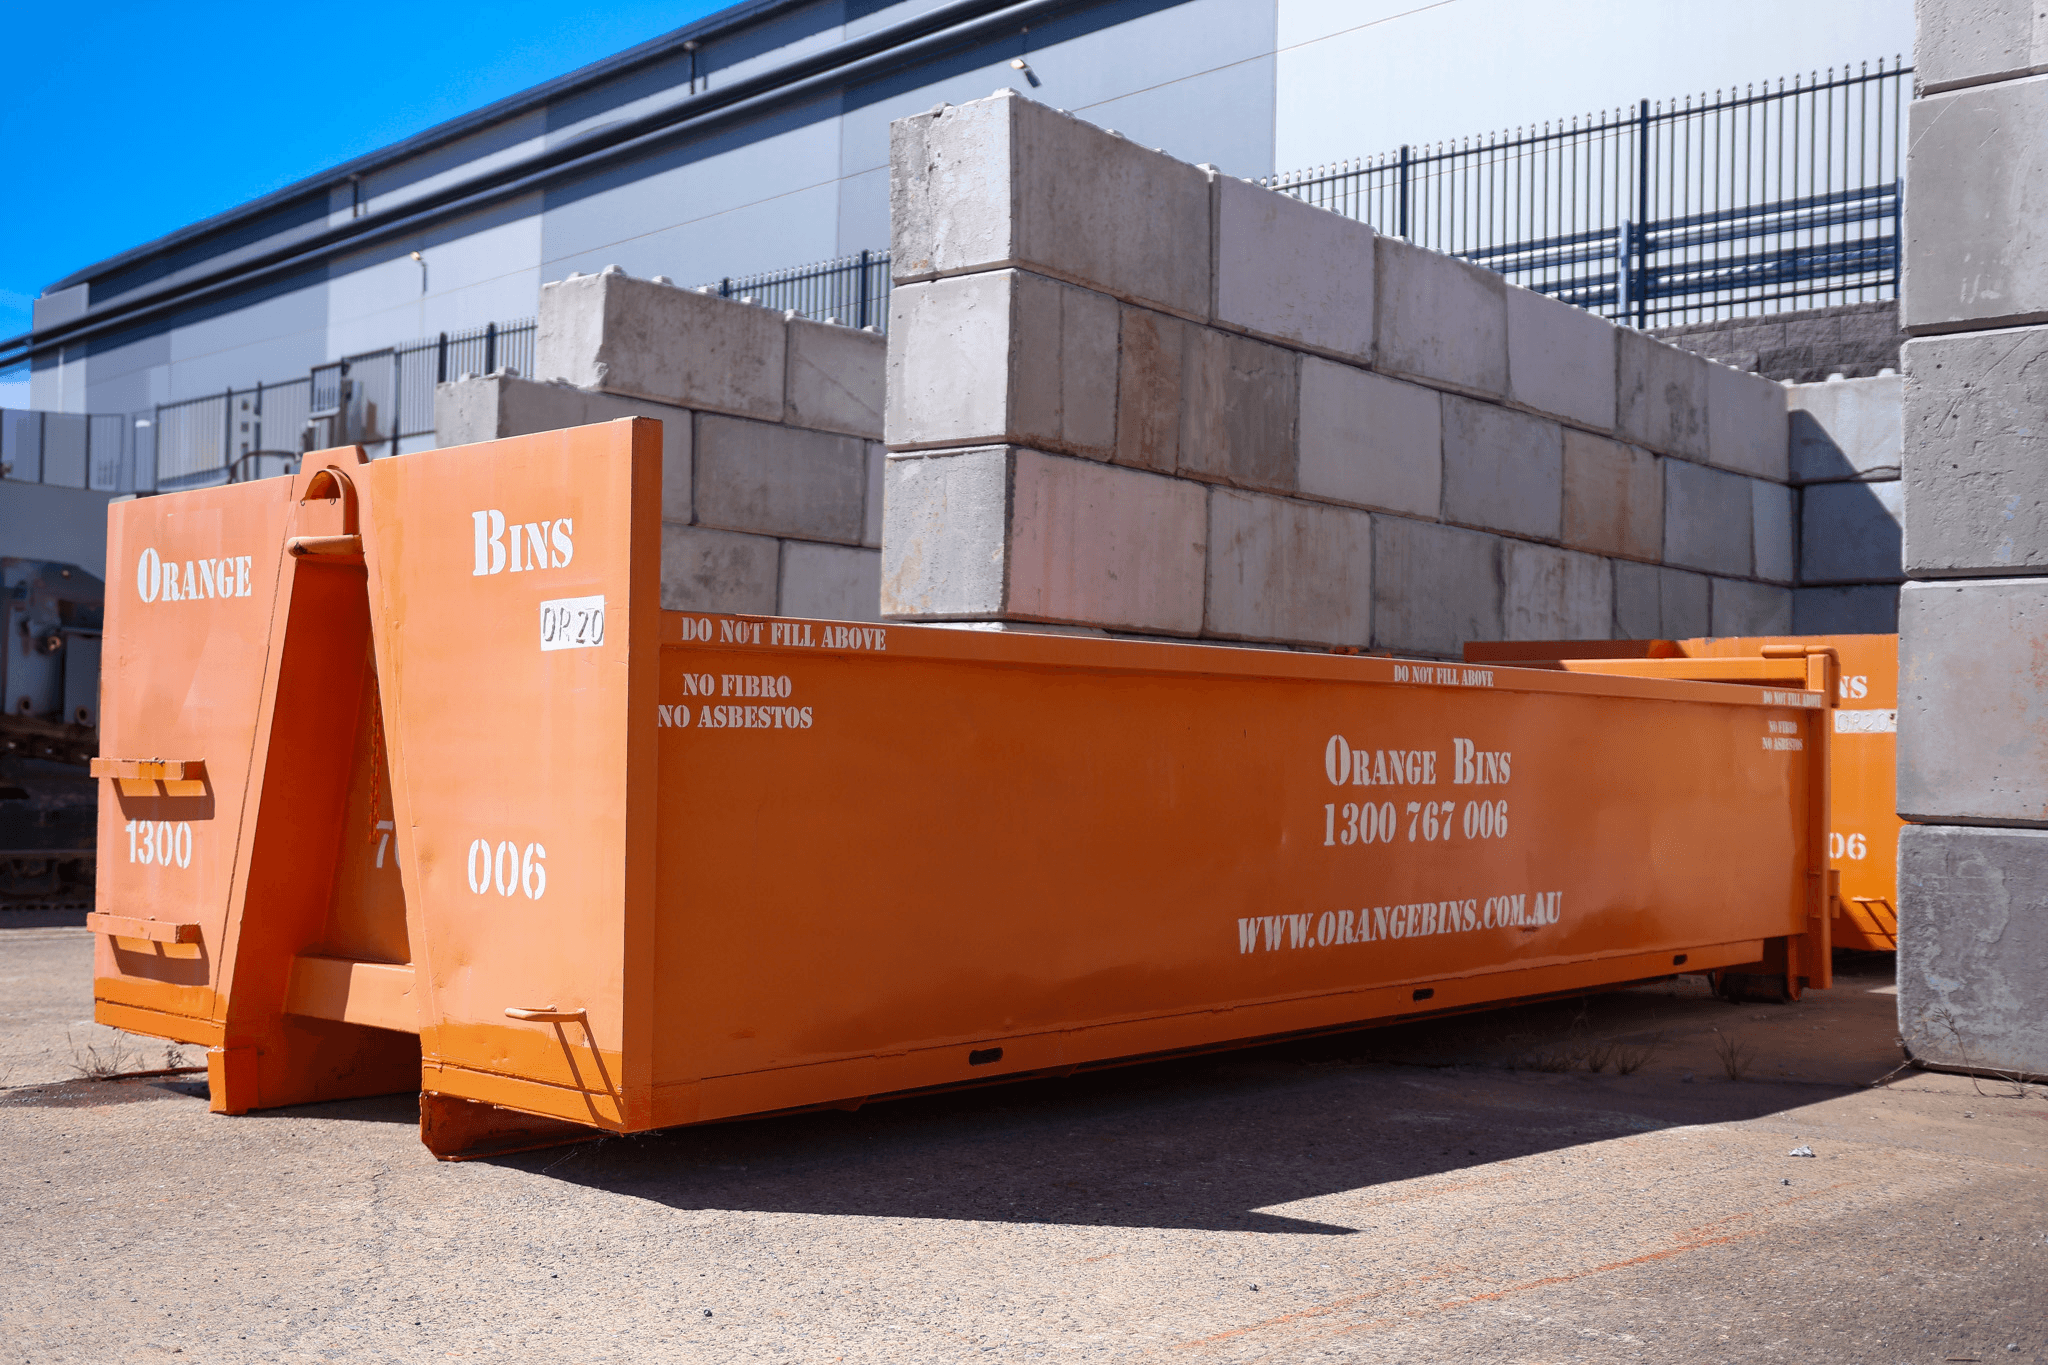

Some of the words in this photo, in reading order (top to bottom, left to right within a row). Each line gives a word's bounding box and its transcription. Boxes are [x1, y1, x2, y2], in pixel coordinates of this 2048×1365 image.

[471, 509, 574, 577] BINS
[137, 547, 252, 603] ORANGE
[681, 617, 713, 642] DO
[719, 619, 764, 645] NOT
[770, 622, 816, 648] FILL
[820, 625, 887, 651] ABOVE
[682, 673, 715, 697] NO
[721, 674, 793, 699] FIBRO
[1393, 664, 1410, 683] DO
[1412, 665, 1434, 684] NOT
[1435, 667, 1460, 686] FILL
[1461, 669, 1494, 687] ABOVE
[657, 704, 691, 728] NO
[697, 704, 813, 729] ASBESTOS
[1325, 734, 1437, 786] ORANGE
[1453, 737, 1512, 785] BINS
[125, 819, 192, 869] 1300
[1323, 801, 1397, 847] 1300
[1406, 800, 1456, 843] 767
[1463, 799, 1509, 840] 006
[467, 838, 547, 901] 006
[1237, 890, 1563, 954] WWW.ORANGEBINS.COM.AU
